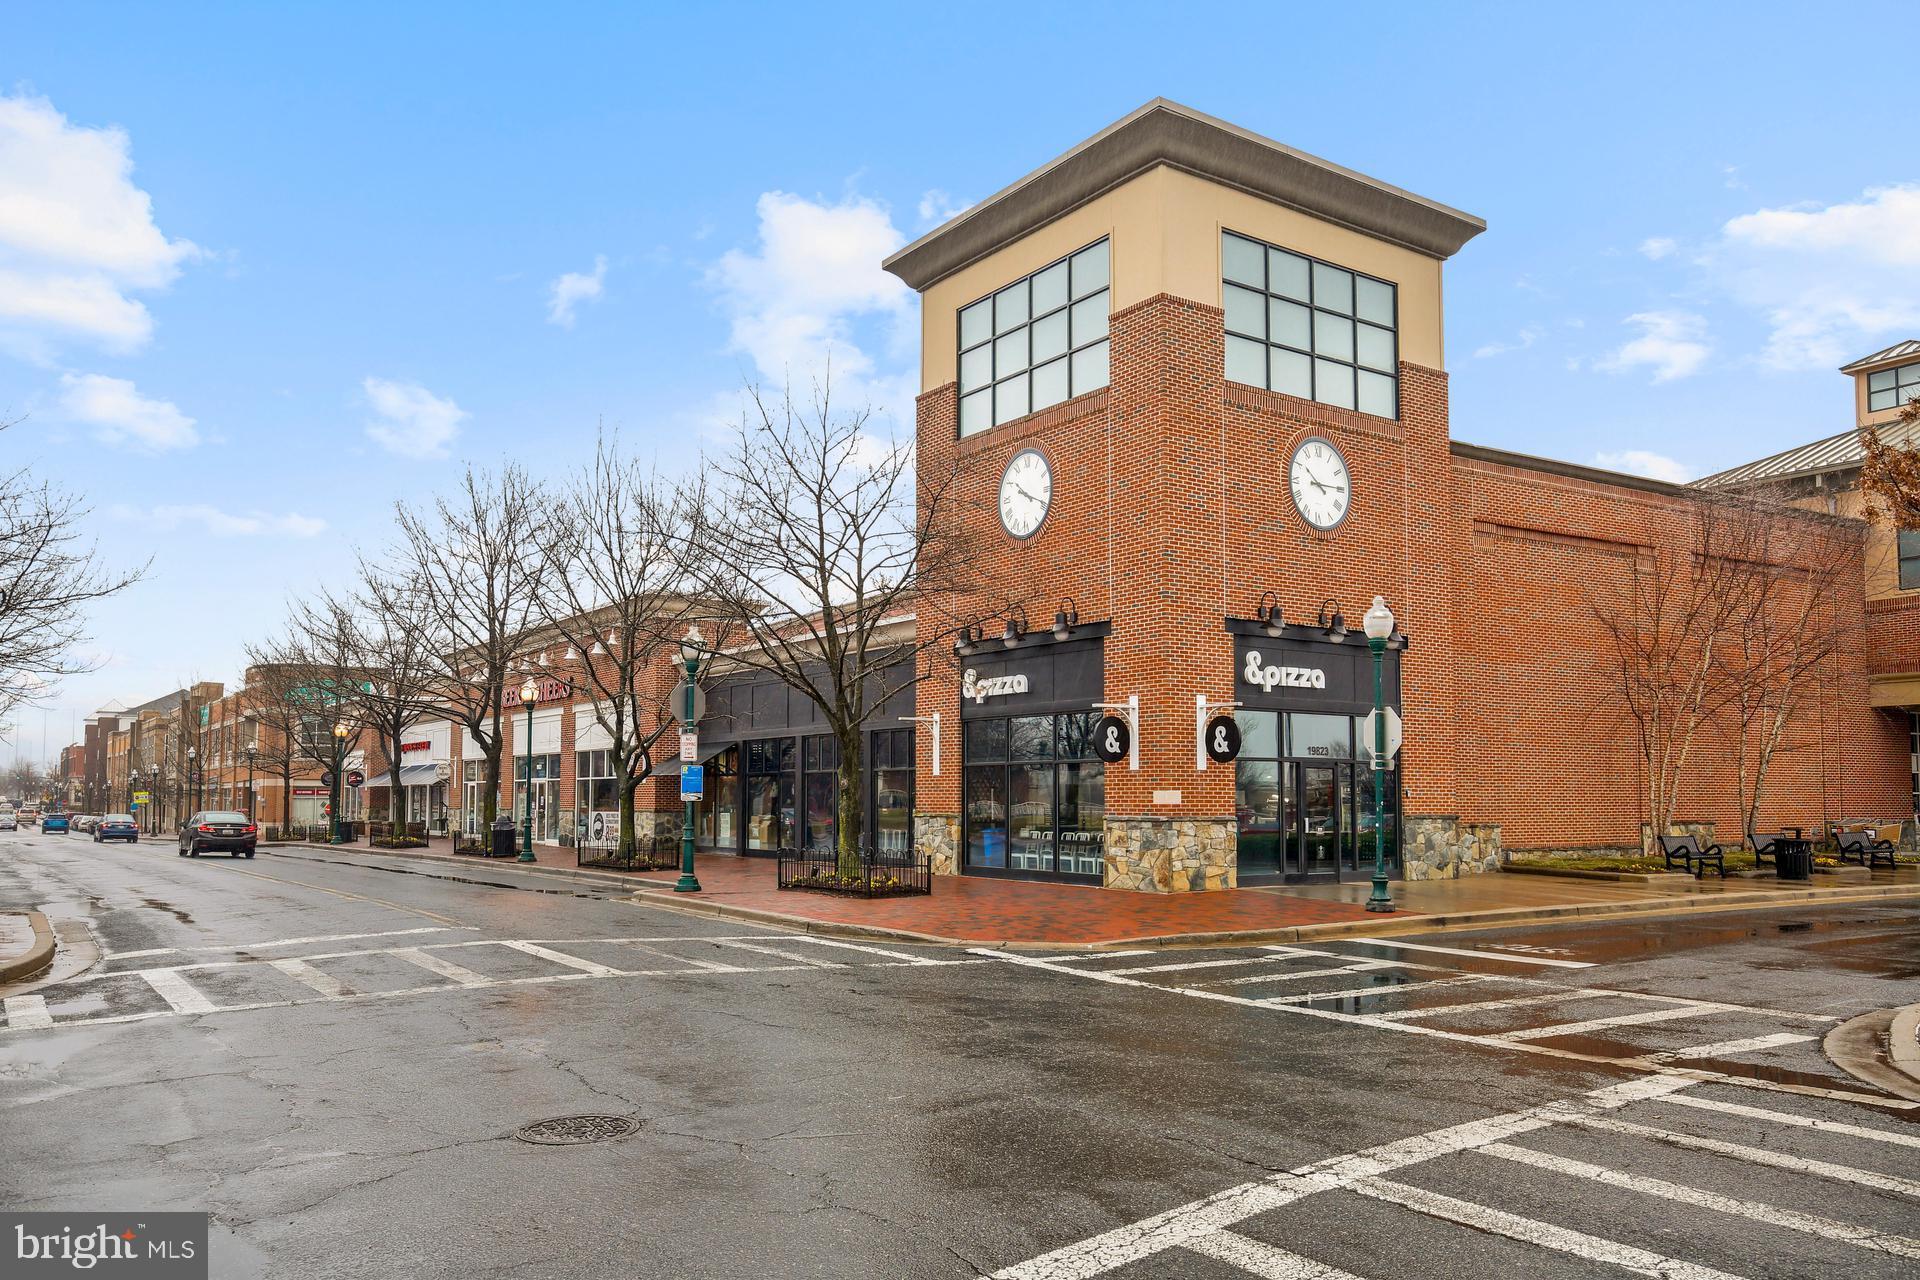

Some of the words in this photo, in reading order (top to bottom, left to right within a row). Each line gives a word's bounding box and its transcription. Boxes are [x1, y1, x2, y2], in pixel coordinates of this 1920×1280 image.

[962, 668, 1029, 704] &pizza
[1244, 650, 1326, 693] &pizza
[1307, 746, 1329, 756] 19823
